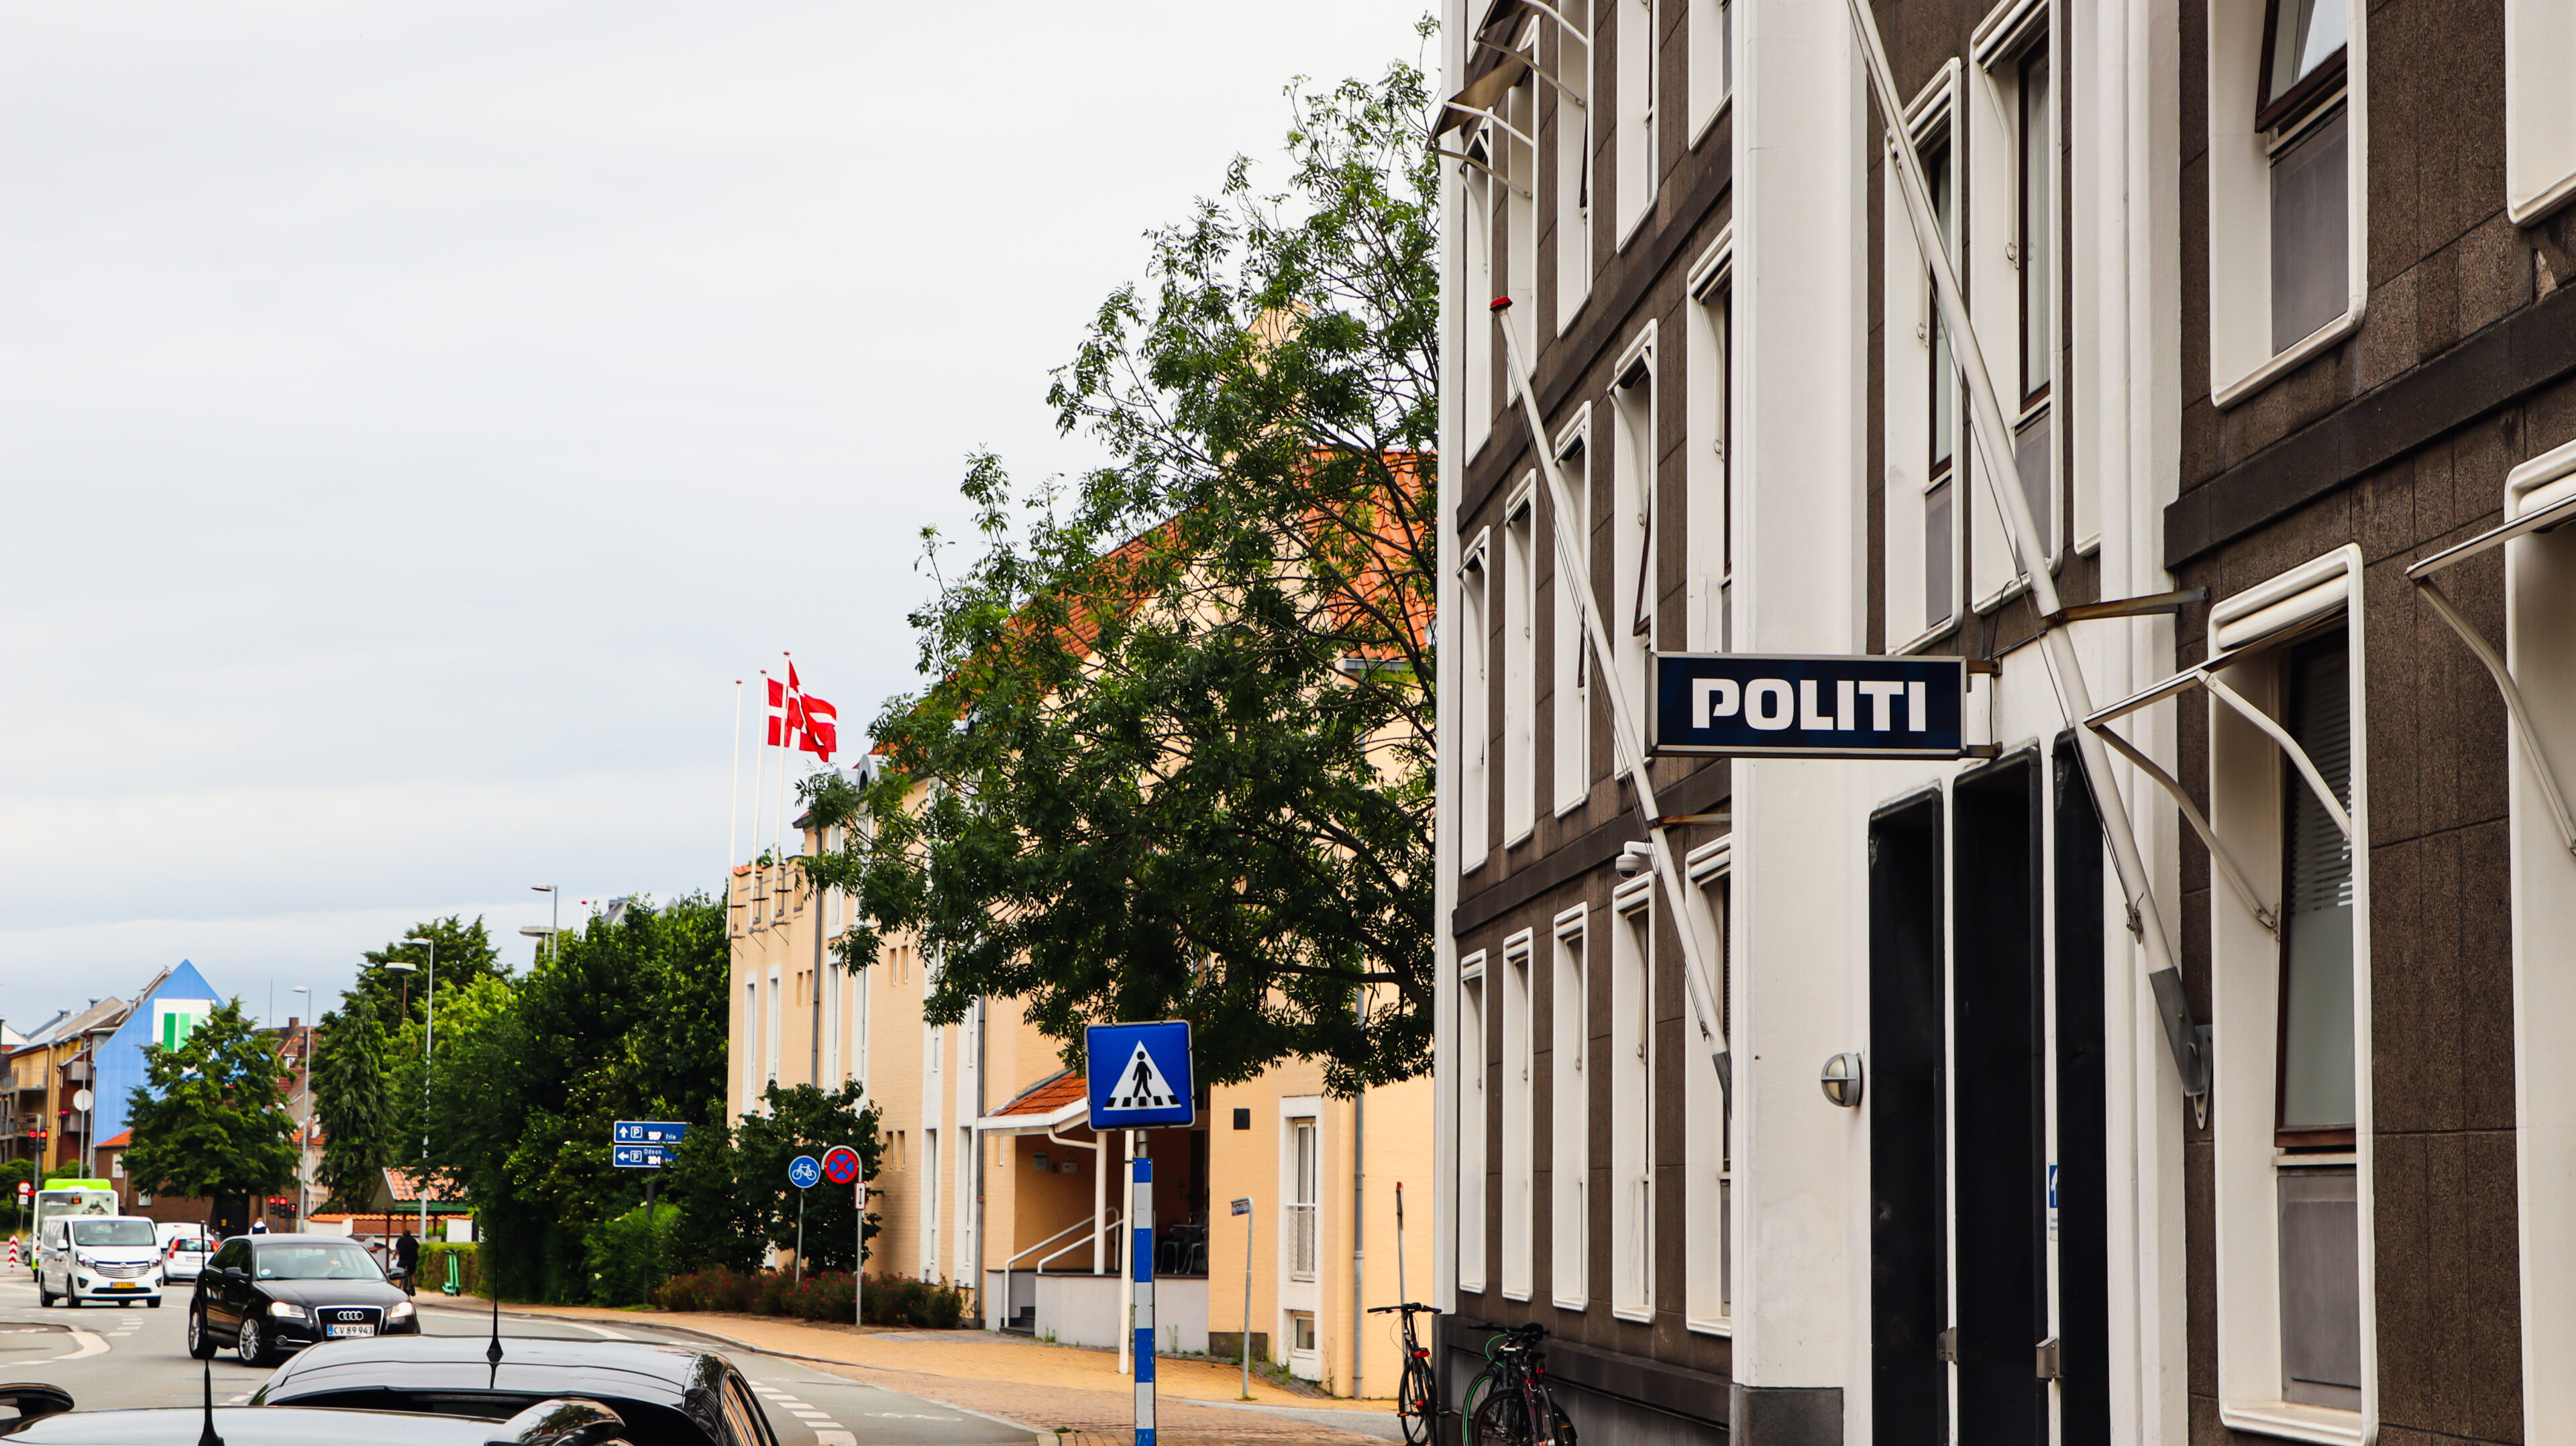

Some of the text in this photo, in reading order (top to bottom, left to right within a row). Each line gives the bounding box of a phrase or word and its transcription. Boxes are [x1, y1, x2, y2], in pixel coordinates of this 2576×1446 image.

[1692, 677, 1926, 732] POLITI
[333, 1326, 373, 1335] CV 89 943
